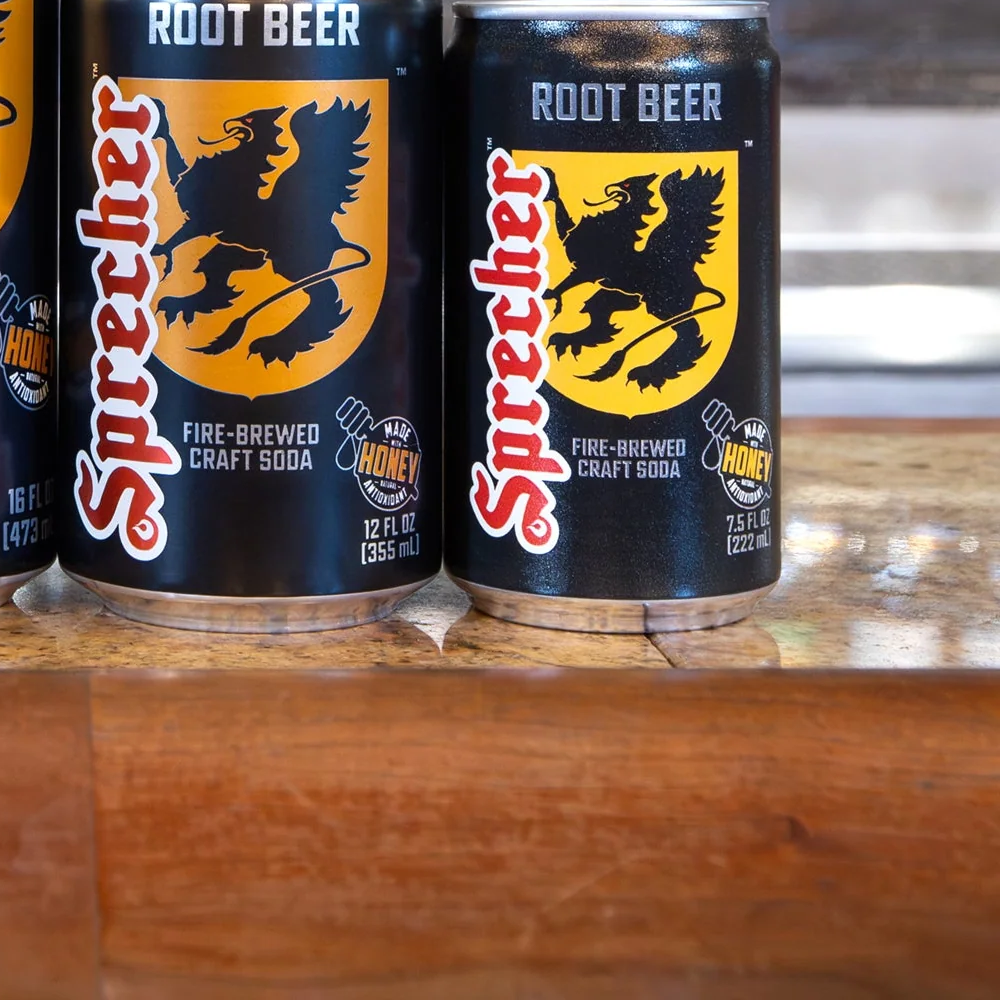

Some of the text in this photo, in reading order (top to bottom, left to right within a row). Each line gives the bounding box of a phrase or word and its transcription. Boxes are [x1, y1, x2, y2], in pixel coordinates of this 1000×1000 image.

[149, 1, 360, 47] ROOT BEER
[532, 82, 722, 122] ROOT BEER
[74, 75, 182, 561] Sprecher
[3, 324, 55, 376] HONE
[470, 148, 571, 554] Sprecher
[183, 421, 320, 446] FIRE-BREWED
[384, 421, 411, 442] MADE
[744, 422, 766, 443] MADE
[190, 448, 313, 471] CRAFT SODA
[572, 437, 686, 458] FIRE-BREWED
[358, 441, 420, 484] HONEY
[578, 459, 681, 479] CRAFT SODA
[722, 441, 772, 483] HONEY
[8, 486, 25, 515] 16
[363, 480, 409, 506] ANTIOXIDANT
[726, 478, 765, 504] ANTIOXIDANT
[364, 512, 416, 540] 12 FL OZ
[726, 508, 770, 533] 7.5 FL OZ
